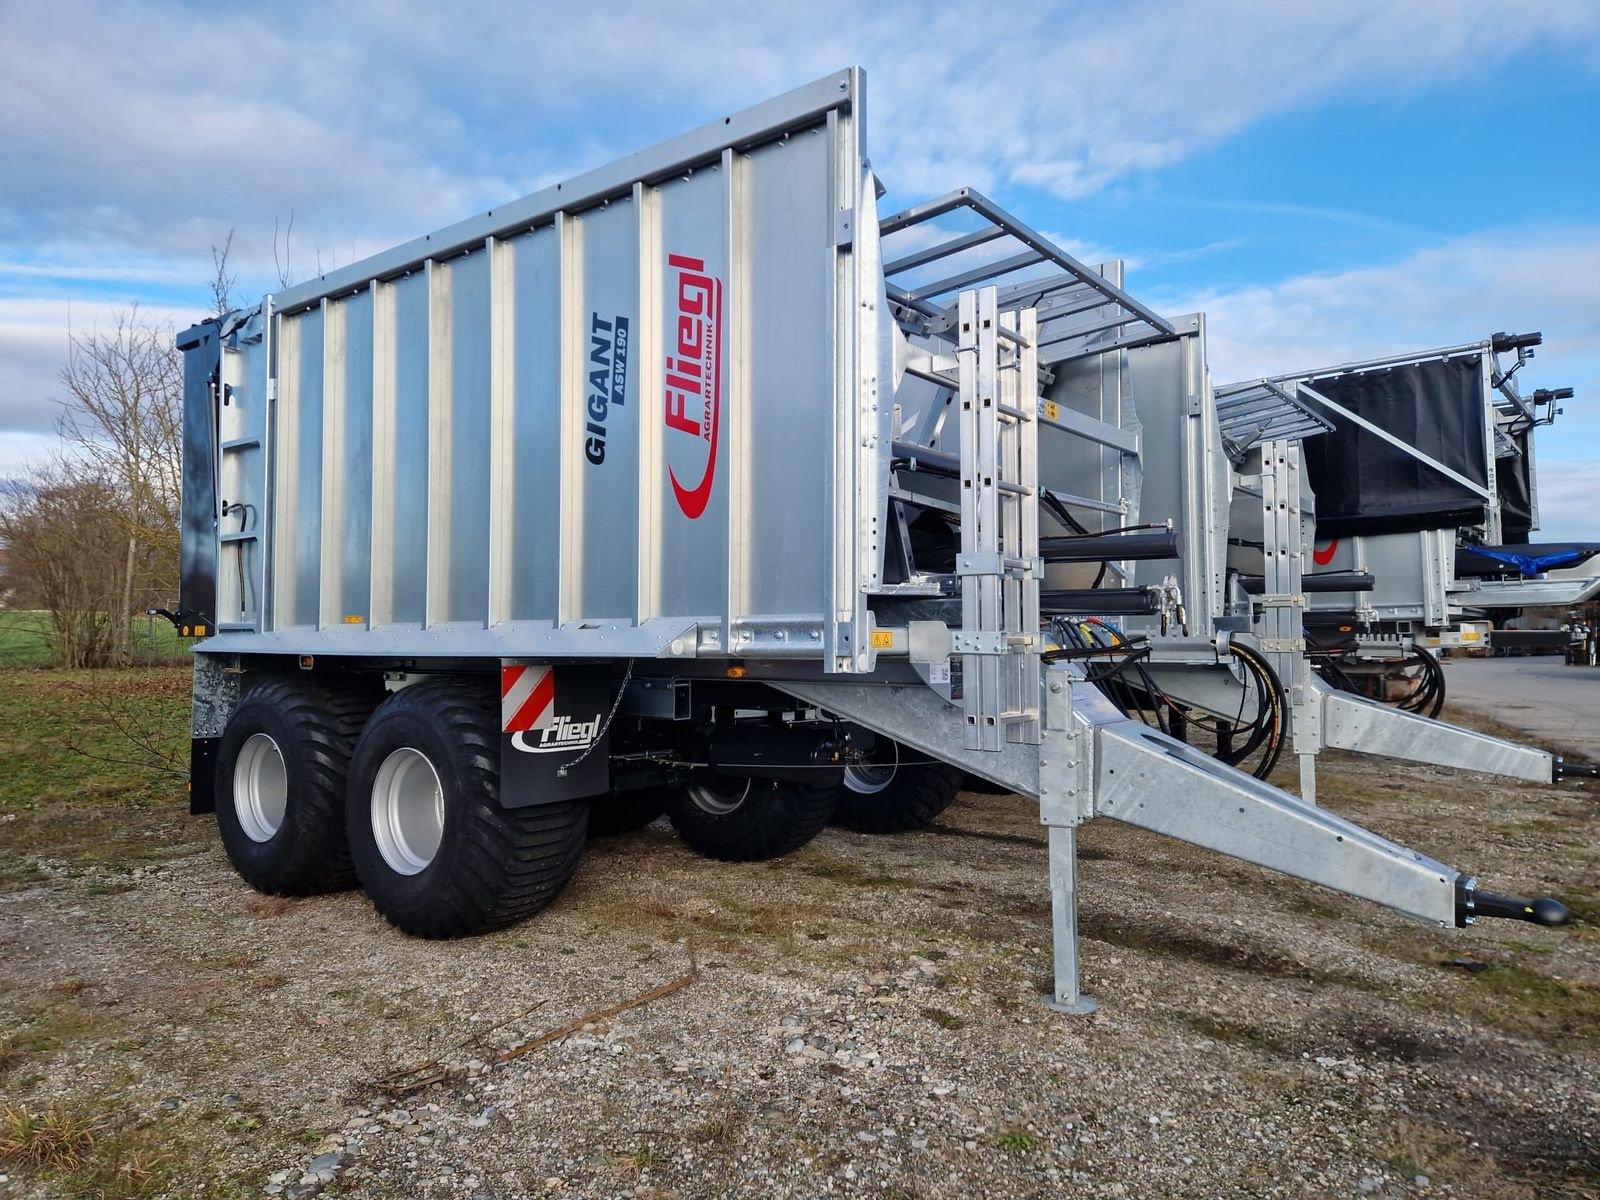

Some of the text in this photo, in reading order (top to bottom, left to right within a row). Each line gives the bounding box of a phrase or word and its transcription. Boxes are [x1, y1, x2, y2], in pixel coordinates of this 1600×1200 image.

[585, 312, 612, 465] GIGANT
[614, 328, 627, 395] ASW 190
[665, 253, 713, 437] Fliegl
[703, 323, 713, 442] AGRARTECHNIK
